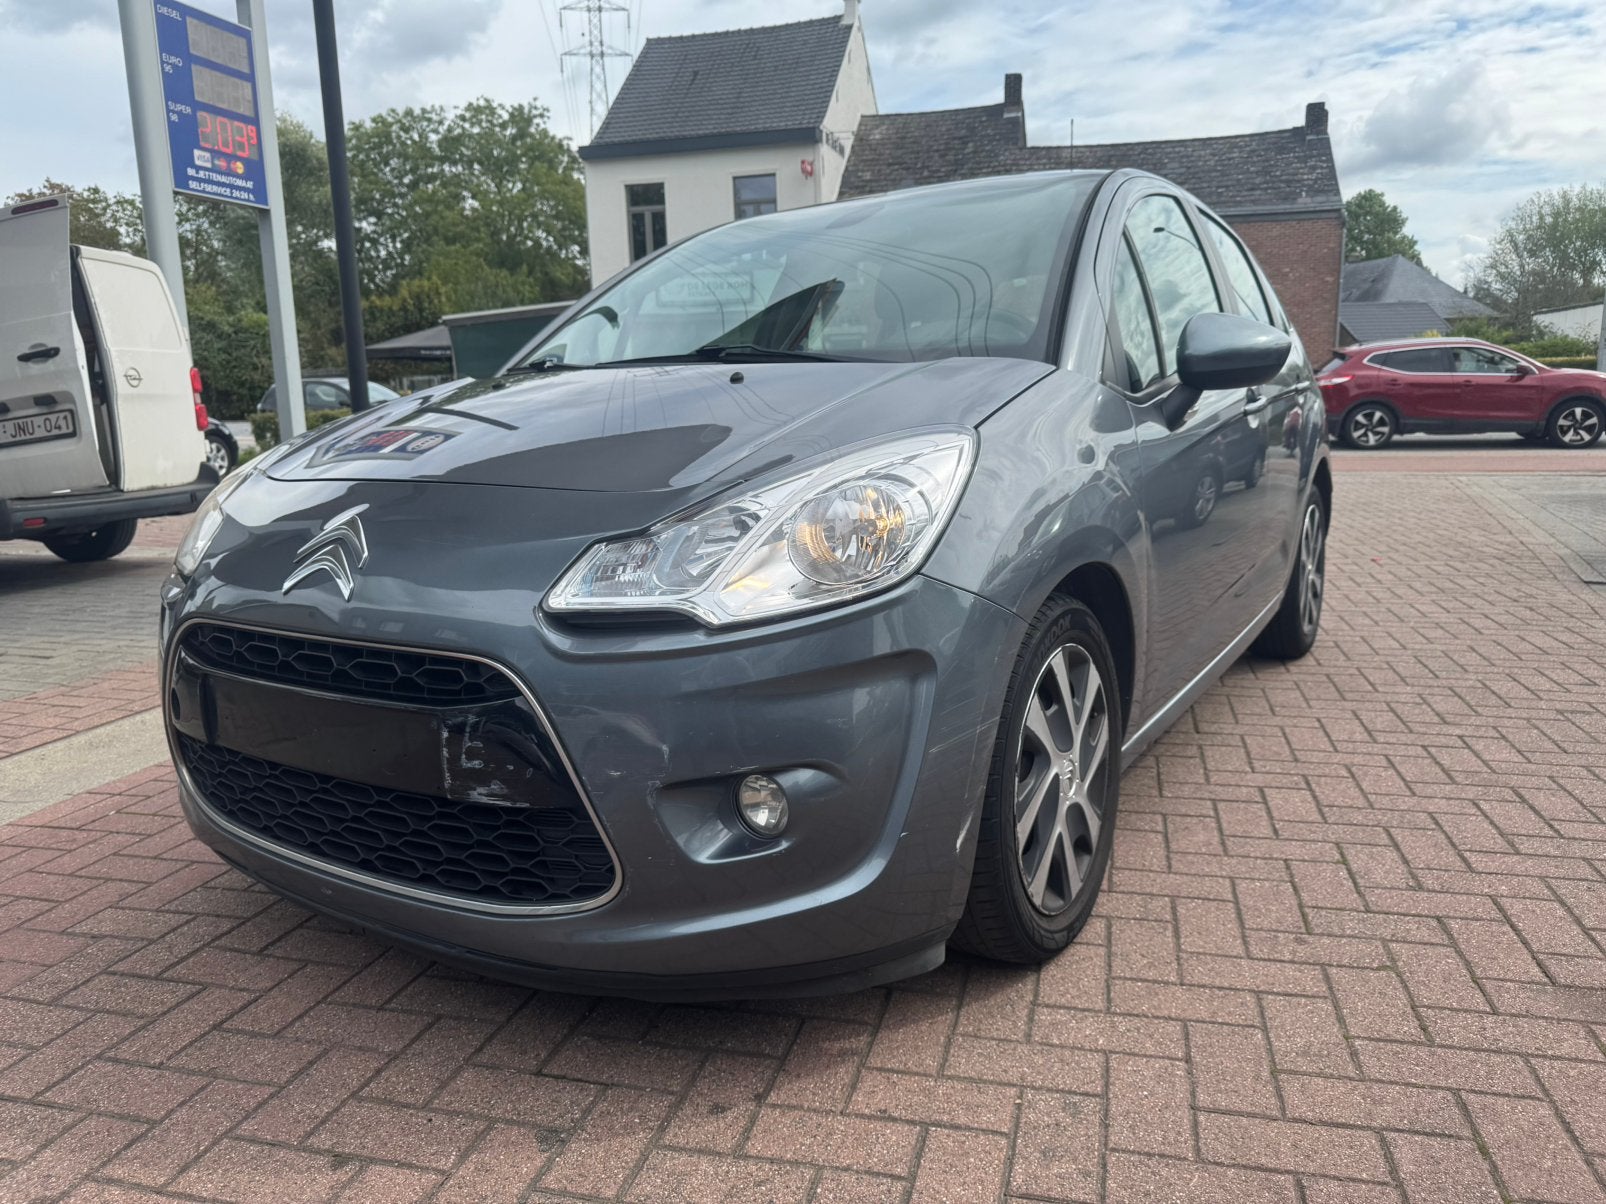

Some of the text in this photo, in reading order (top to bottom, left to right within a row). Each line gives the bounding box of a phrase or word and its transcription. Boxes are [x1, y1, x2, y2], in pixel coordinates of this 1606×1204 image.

[156, 4, 182, 21] DIESEL
[162, 53, 183, 67] EURO
[163, 63, 174, 74] 95
[168, 101, 192, 115] SUPER
[187, 167, 254, 189] BILJETTENAUTOMAAT
[188, 180, 231, 197] SELFSERVICE
